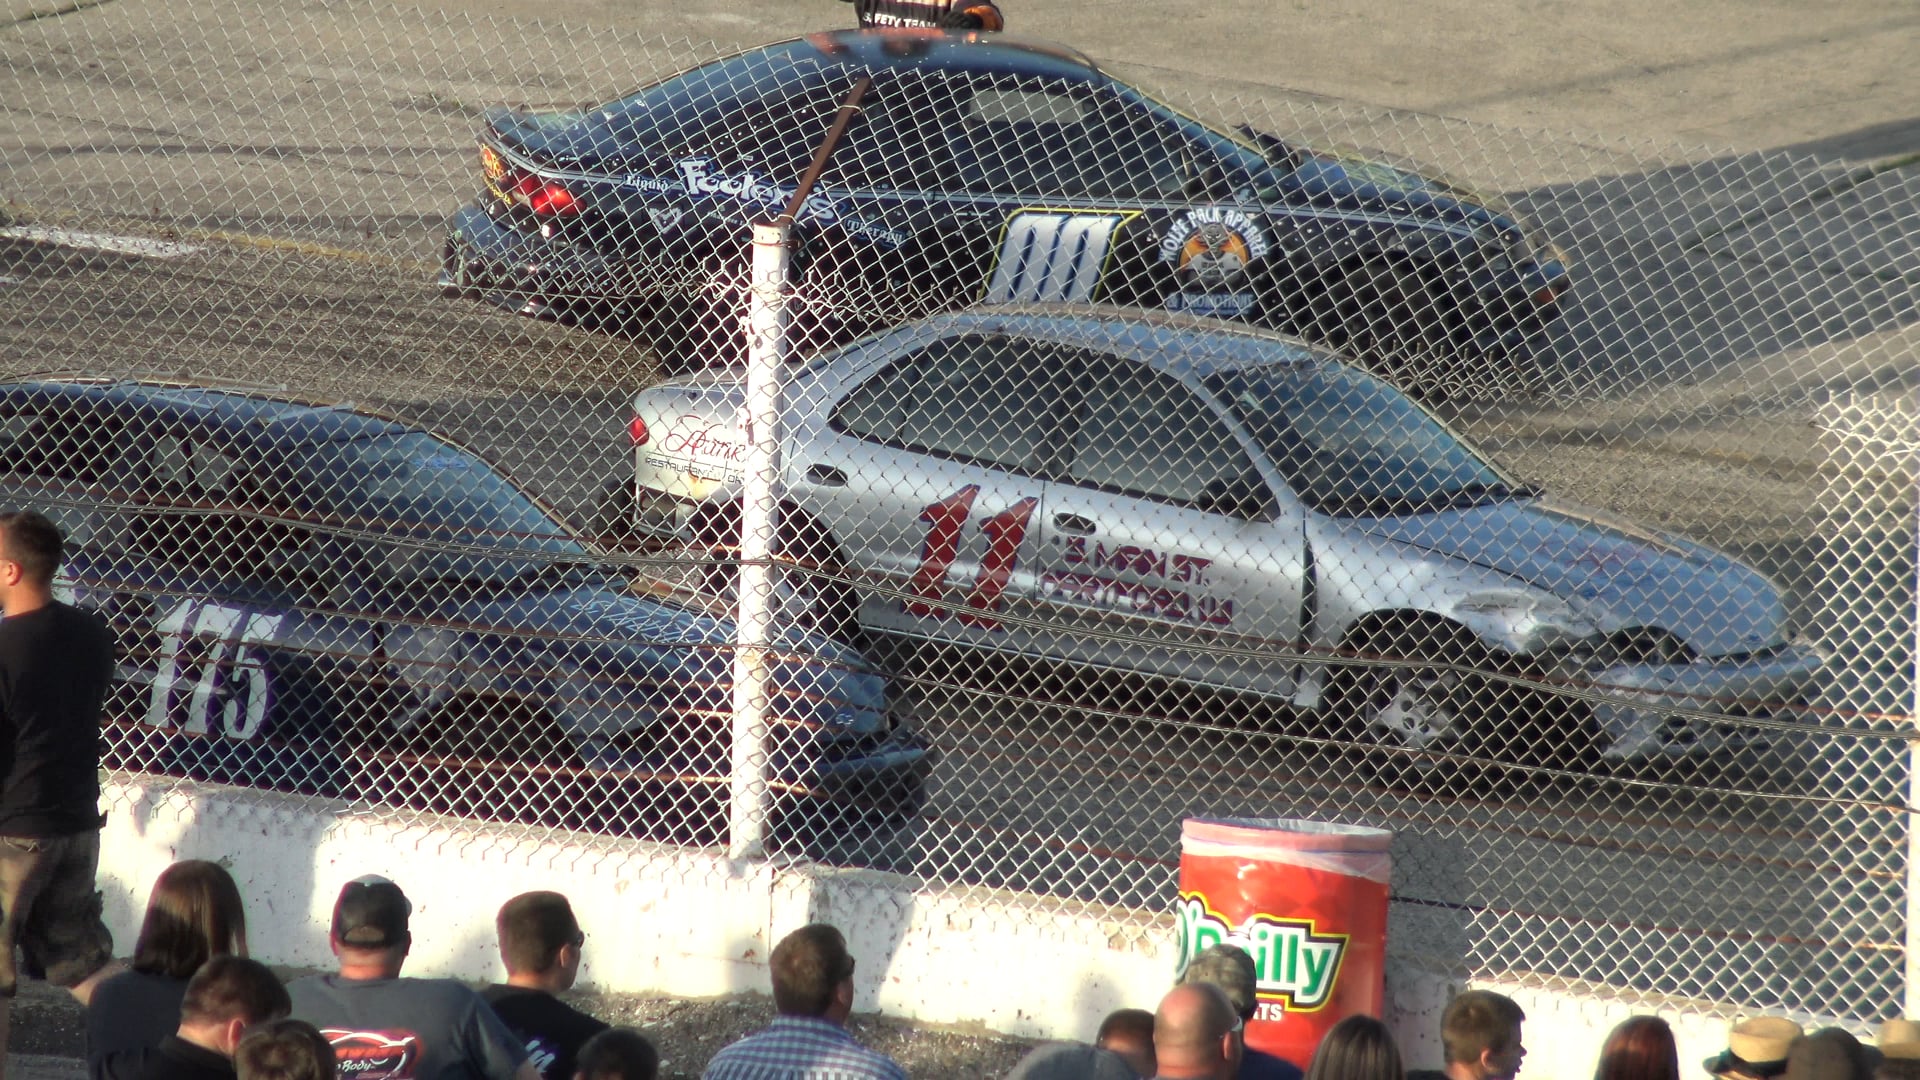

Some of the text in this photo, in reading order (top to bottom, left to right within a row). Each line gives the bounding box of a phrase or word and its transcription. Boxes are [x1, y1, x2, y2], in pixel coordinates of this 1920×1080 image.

[863, 11, 901, 28] SFETY
[1186, 206, 1221, 228] PACK
[846, 219, 904, 244] Therapy
[902, 482, 1040, 632] 11
[144, 599, 284, 740] 175
